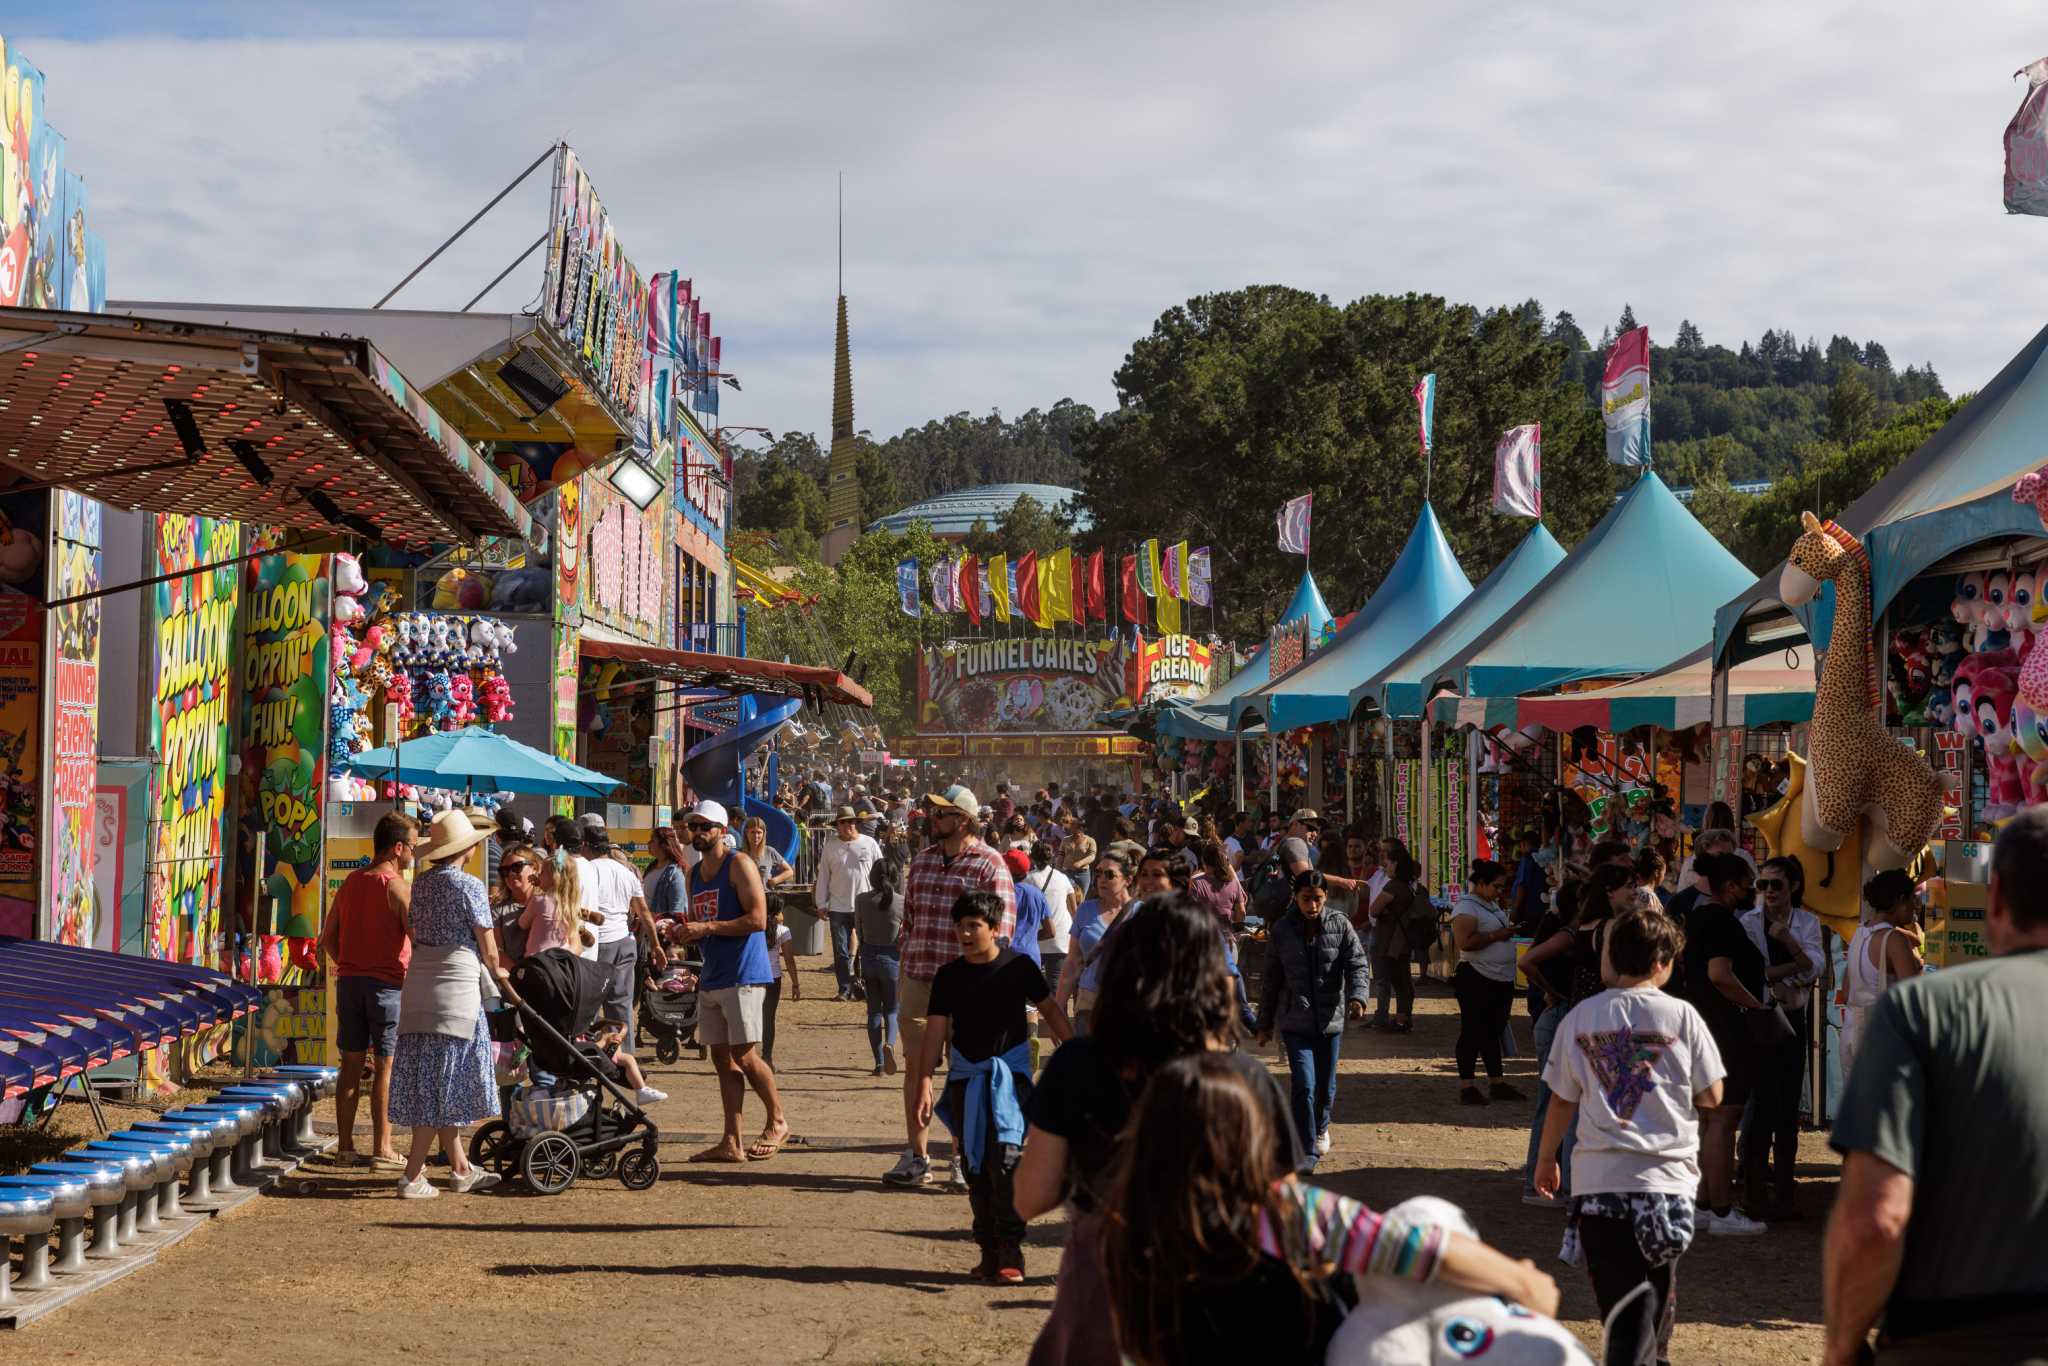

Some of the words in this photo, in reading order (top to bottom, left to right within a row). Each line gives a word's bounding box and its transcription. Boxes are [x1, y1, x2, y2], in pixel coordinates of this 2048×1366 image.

[246, 578, 313, 638] LLOON
[159, 600, 229, 704] BALLOON
[244, 633, 310, 693] OPPIN'
[956, 639, 1030, 679] FUNNEL
[1032, 638, 1098, 674] CAKES
[1165, 634, 1191, 657] ICE
[1150, 658, 1205, 684] CREAM
[250, 695, 298, 748] FUN!
[341, 804, 353, 816] 57
[1397, 764, 1409, 812] PRIZE
[1447, 763, 1459, 812] PRIZE
[259, 789, 319, 841] POP!
[173, 796, 214, 901] FUN!
[1447, 815, 1460, 904] EVERYTIME
[1962, 844, 1978, 857] 66
